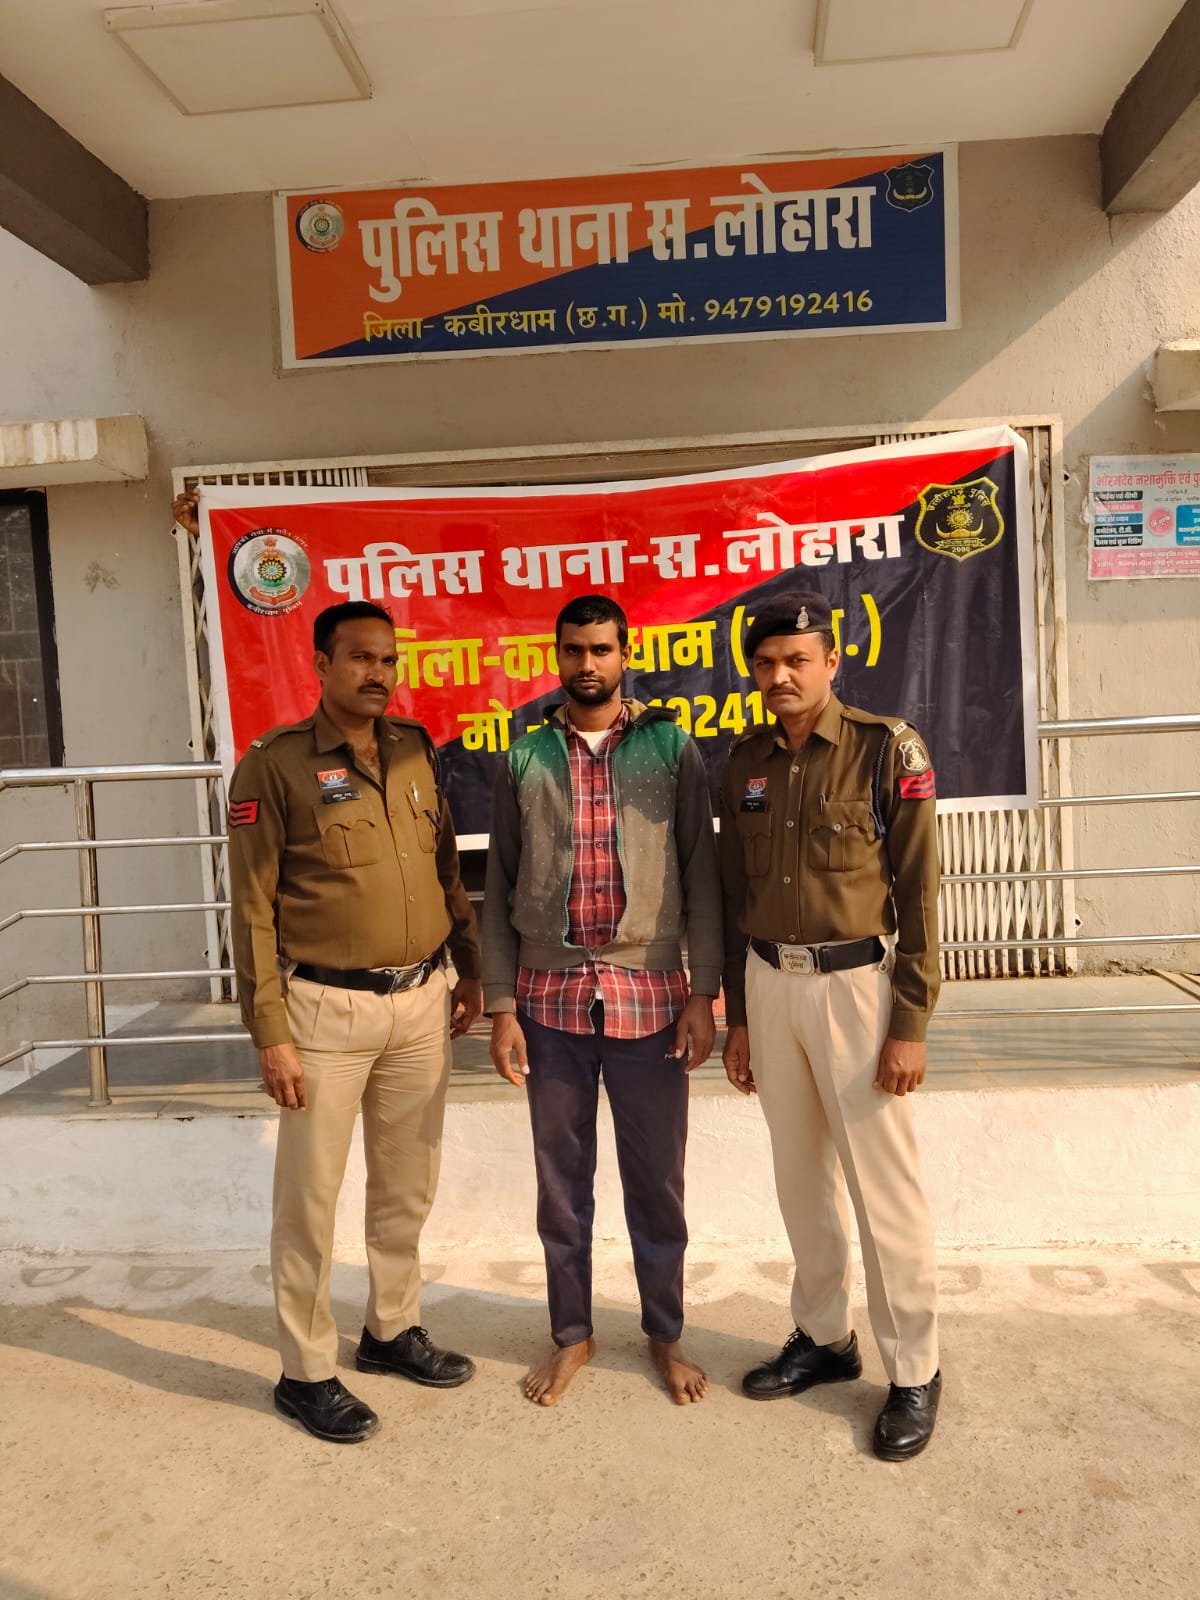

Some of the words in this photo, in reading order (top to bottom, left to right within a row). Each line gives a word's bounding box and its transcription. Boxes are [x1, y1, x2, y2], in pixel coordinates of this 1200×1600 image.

[358, 197, 503, 303] पुलिस
[518, 202, 632, 268] थाना
[363, 311, 434, 343] जिला-
[443, 304, 556, 337] कबीरधाम
[657, 292, 696, 324] मो.
[704, 289, 873, 320] 9479192416
[457, 698, 513, 752] मो
